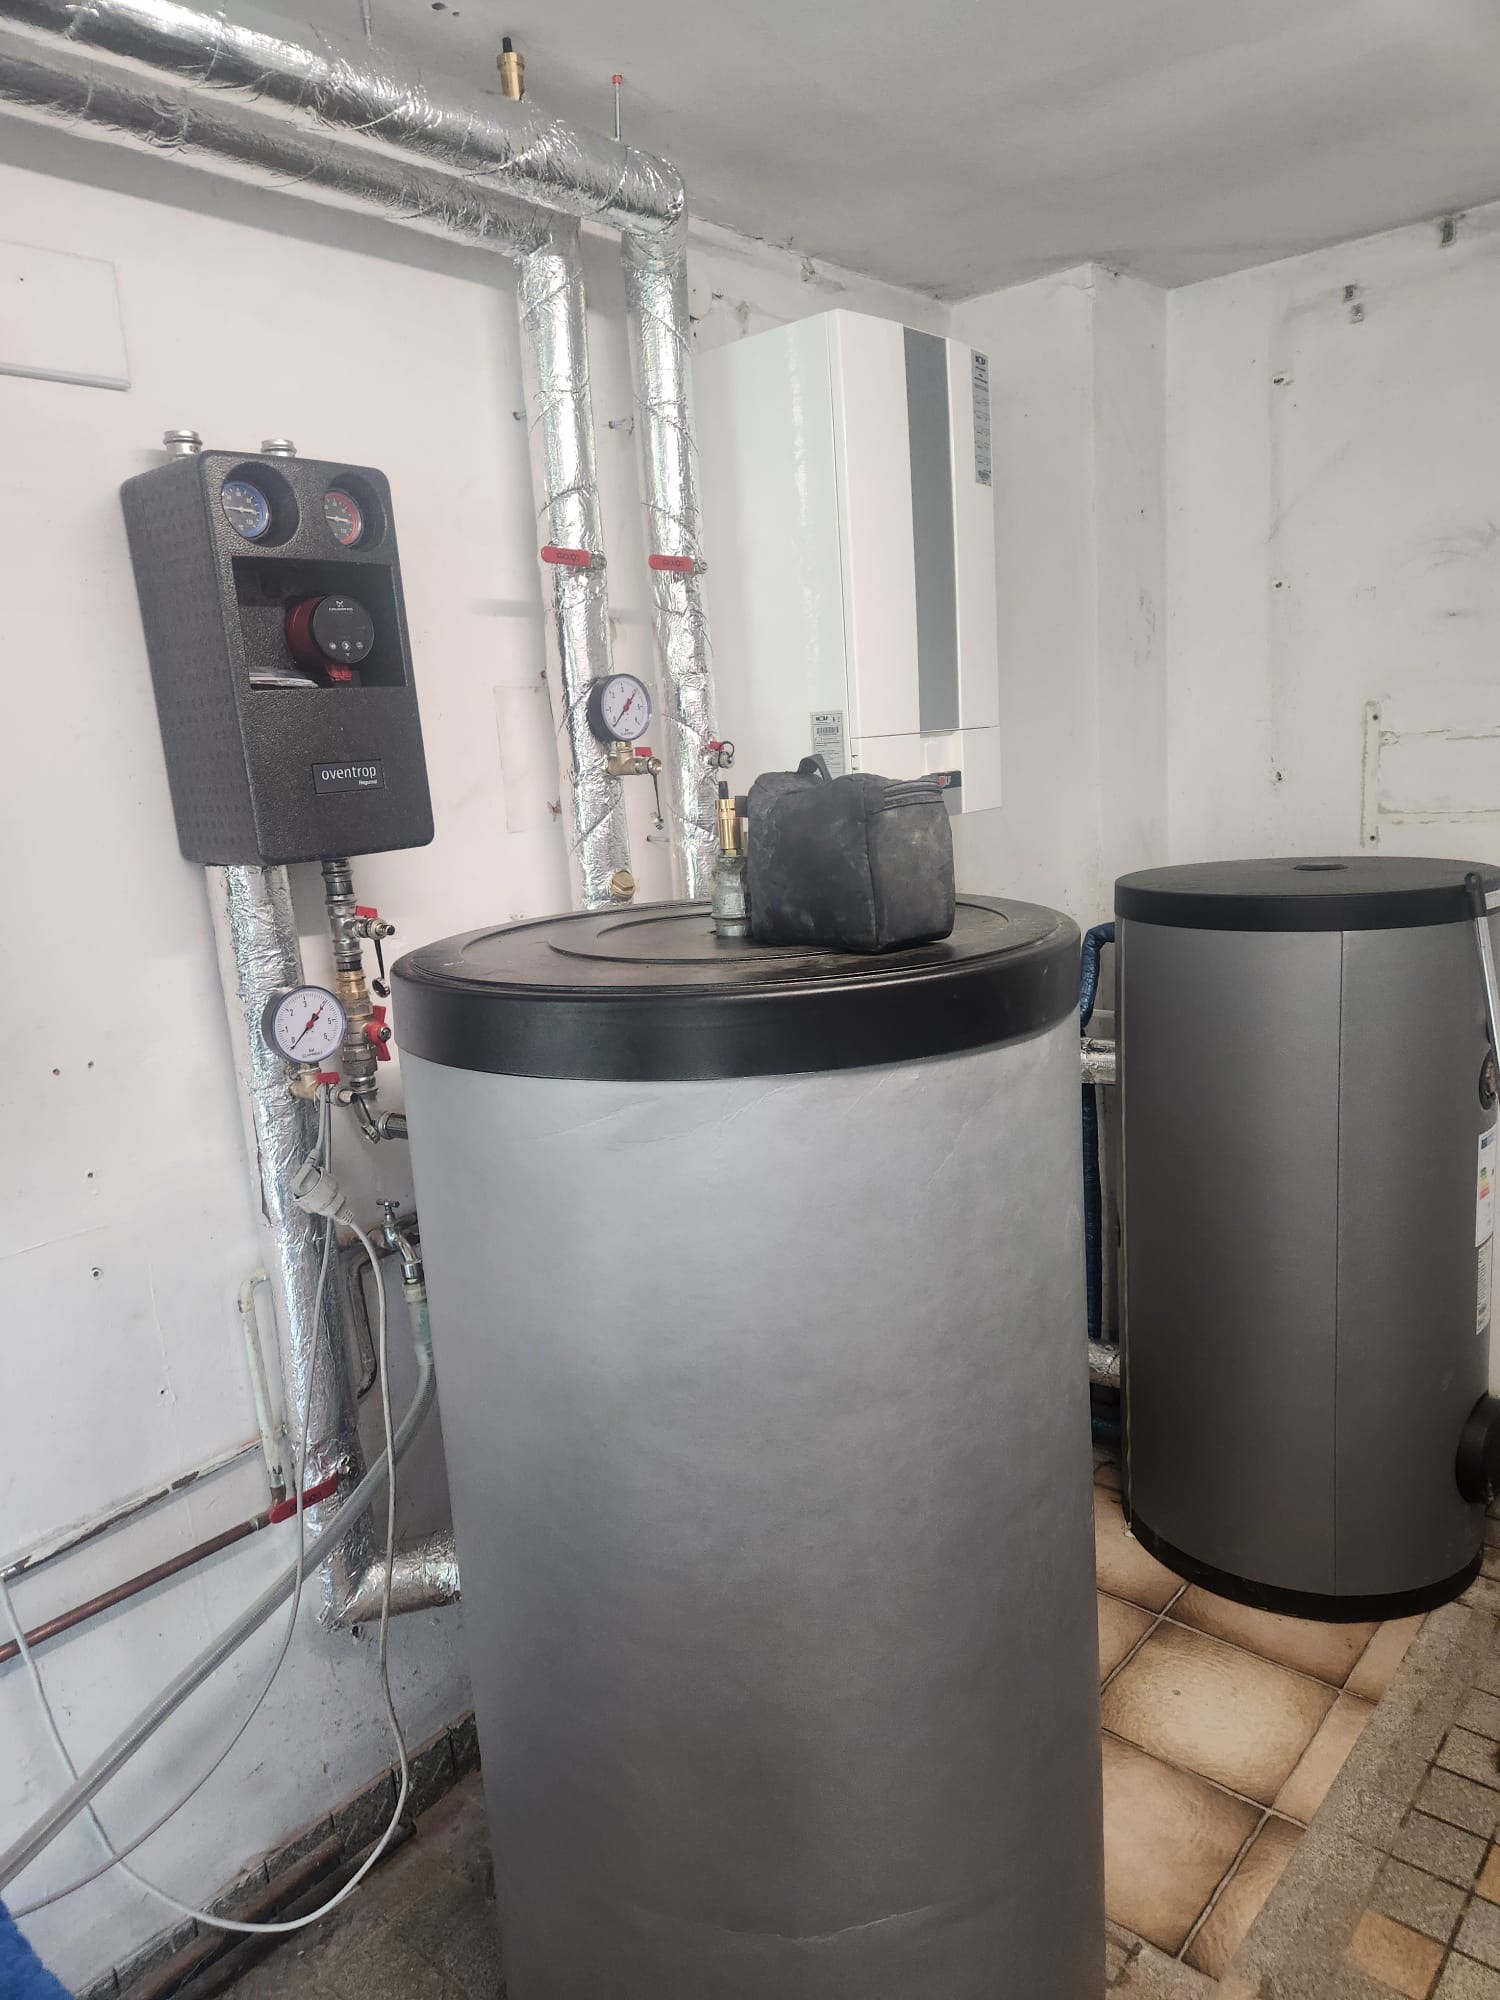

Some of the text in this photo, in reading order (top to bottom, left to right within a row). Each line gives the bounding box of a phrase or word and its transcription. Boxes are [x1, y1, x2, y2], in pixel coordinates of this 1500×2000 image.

[321, 766, 377, 780] oventrop
[290, 1008, 294, 1016] 2
[327, 1017, 332, 1025] 5
